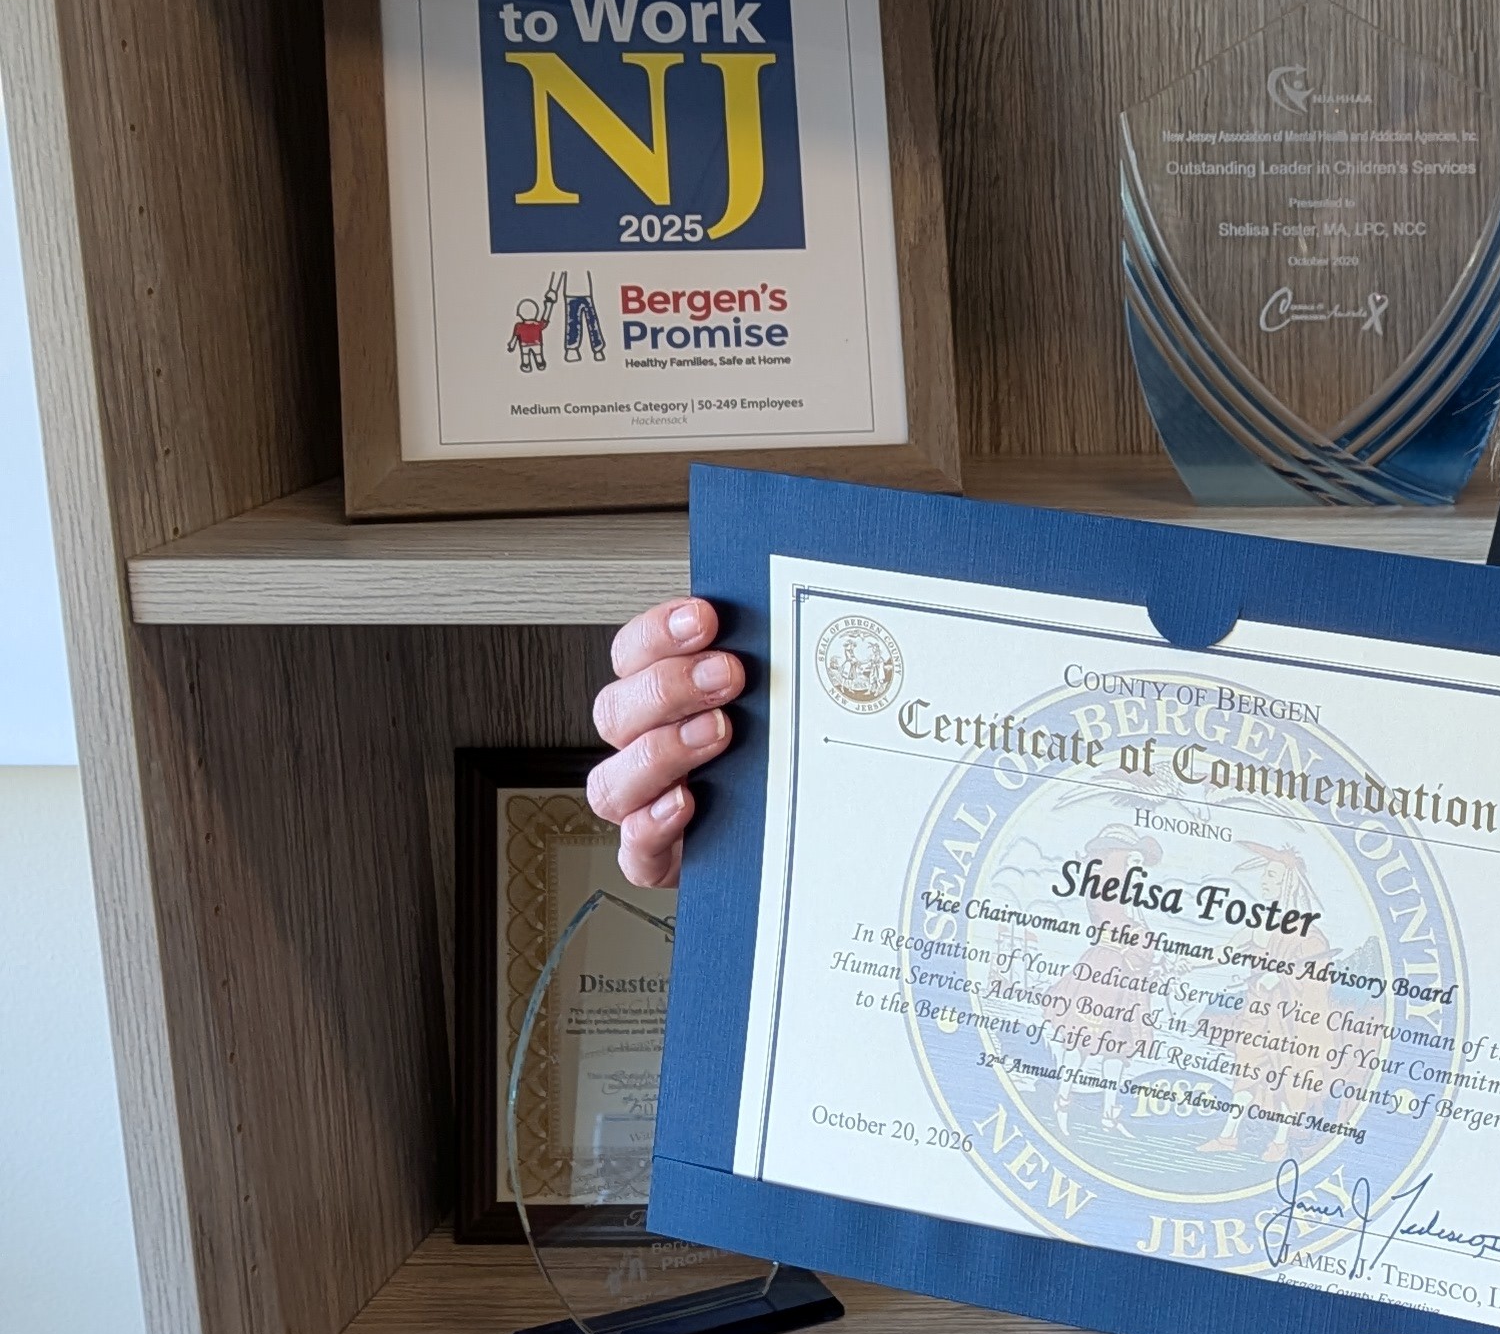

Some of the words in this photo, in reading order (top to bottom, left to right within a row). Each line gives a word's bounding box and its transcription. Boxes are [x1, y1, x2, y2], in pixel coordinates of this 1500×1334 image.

[499, 1, 558, 44] to
[505, 51, 777, 240] NJ
[1166, 160, 1256, 178] Outstanding
[1260, 160, 1312, 175] Leader
[1316, 160, 1330, 175] in
[1412, 160, 1476, 175] Services
[618, 214, 705, 244] 2025
[1218, 222, 1269, 237] Shelisa
[1272, 222, 1320, 238] Foster,
[1323, 222, 1351, 238] MA,
[1355, 222, 1389, 238] LPC,
[1393, 221, 1427, 236] NCC
[1288, 256, 1329, 266] October
[620, 282, 788, 322] Bergen's
[622, 316, 789, 351] Promise
[625, 357, 668, 370] Healthy
[670, 355, 718, 368] Families,
[719, 355, 743, 367] Safe
[745, 356, 756, 366] at
[758, 354, 792, 366] Home
[510, 403, 561, 417] Medium
[563, 401, 632, 416] Companies
[633, 400, 688, 416] Category
[697, 398, 738, 411] 50-249
[740, 397, 804, 412] Employees
[630, 415, 688, 426] Hackensack
[818, 637, 830, 662] SEAL
[830, 623, 840, 635] OF
[844, 619, 882, 634] BERGEN
[884, 635, 902, 675] COUNTY
[829, 687, 848, 706] NEW
[855, 695, 889, 711] JERSEY
[1063, 664, 1168, 700] COUNTY
[1176, 685, 1207, 706] OF
[1215, 686, 1320, 724] BERGEN
[898, 698, 1103, 768] Certificate
[1119, 737, 1156, 776] of
[1172, 743, 1497, 832] Commendation
[1134, 807, 1231, 842] HONORING
[923, 803, 999, 943] SEAL
[1051, 858, 1182, 914] Shelisa
[1196, 885, 1321, 937] Foster
[920, 890, 960, 913] Vice
[965, 898, 1080, 935] Chairwoman
[1085, 920, 1110, 946] of
[1110, 924, 1139, 946] the
[1142, 931, 1213, 960] Human
[1218, 945, 1294, 976] Services
[1295, 960, 1387, 998] Advisory
[1391, 977, 1458, 1004] Board
[579, 974, 670, 994] Disaster
[852, 923, 873, 942] In
[880, 927, 989, 963] Recognition
[996, 949, 1021, 973] of
[1021, 952, 1069, 976] Your
[1072, 962, 1172, 996] Dedicated
[1176, 982, 1243, 1010] Service
[1249, 1000, 1270, 1015] as
[1277, 1000, 1320, 1024] Vice
[1326, 1010, 1454, 1051] Chairwoman
[1461, 1036, 1489, 1062] of
[830, 951, 900, 980] Human
[905, 965, 981, 994] Services
[982, 979, 1071, 1016] Advisory
[1076, 996, 1138, 1022] Board
[1168, 1017, 1186, 1032] in
[1191, 1018, 1319, 1058] Appreciation
[1326, 1043, 1352, 1069] of
[1353, 1048, 1404, 1074] Your
[856, 990, 874, 1007] to
[880, 991, 909, 1014] the
[914, 999, 1020, 1033] Betterment
[1026, 1019, 1048, 1044] of
[1050, 1024, 1091, 1051] Life
[1091, 1030, 1127, 1056] for
[1126, 1039, 1166, 1060] All
[1167, 1046, 1260, 1080] Residents
[1265, 1065, 1292, 1091] of
[1292, 1069, 1323, 1092] the
[1329, 1078, 1402, 1114] County
[1408, 1093, 1433, 1119] of
[1006, 1058, 1064, 1080] Annual
[1063, 1064, 1116, 1090] Human
[1119, 1079, 1176, 1101] Services
[1178, 1090, 1244, 1119] Advisory
[1247, 1104, 1305, 1126] Council
[1304, 1115, 1366, 1144] Meeting
[812, 1105, 886, 1135] October
[890, 1120, 918, 1145] 20,
[926, 1126, 972, 1152] 2026
[972, 1103, 1098, 1218] NEW
[1278, 1243, 1347, 1276] JAMES
[1381, 1262, 1481, 1307] TEDESCO,
